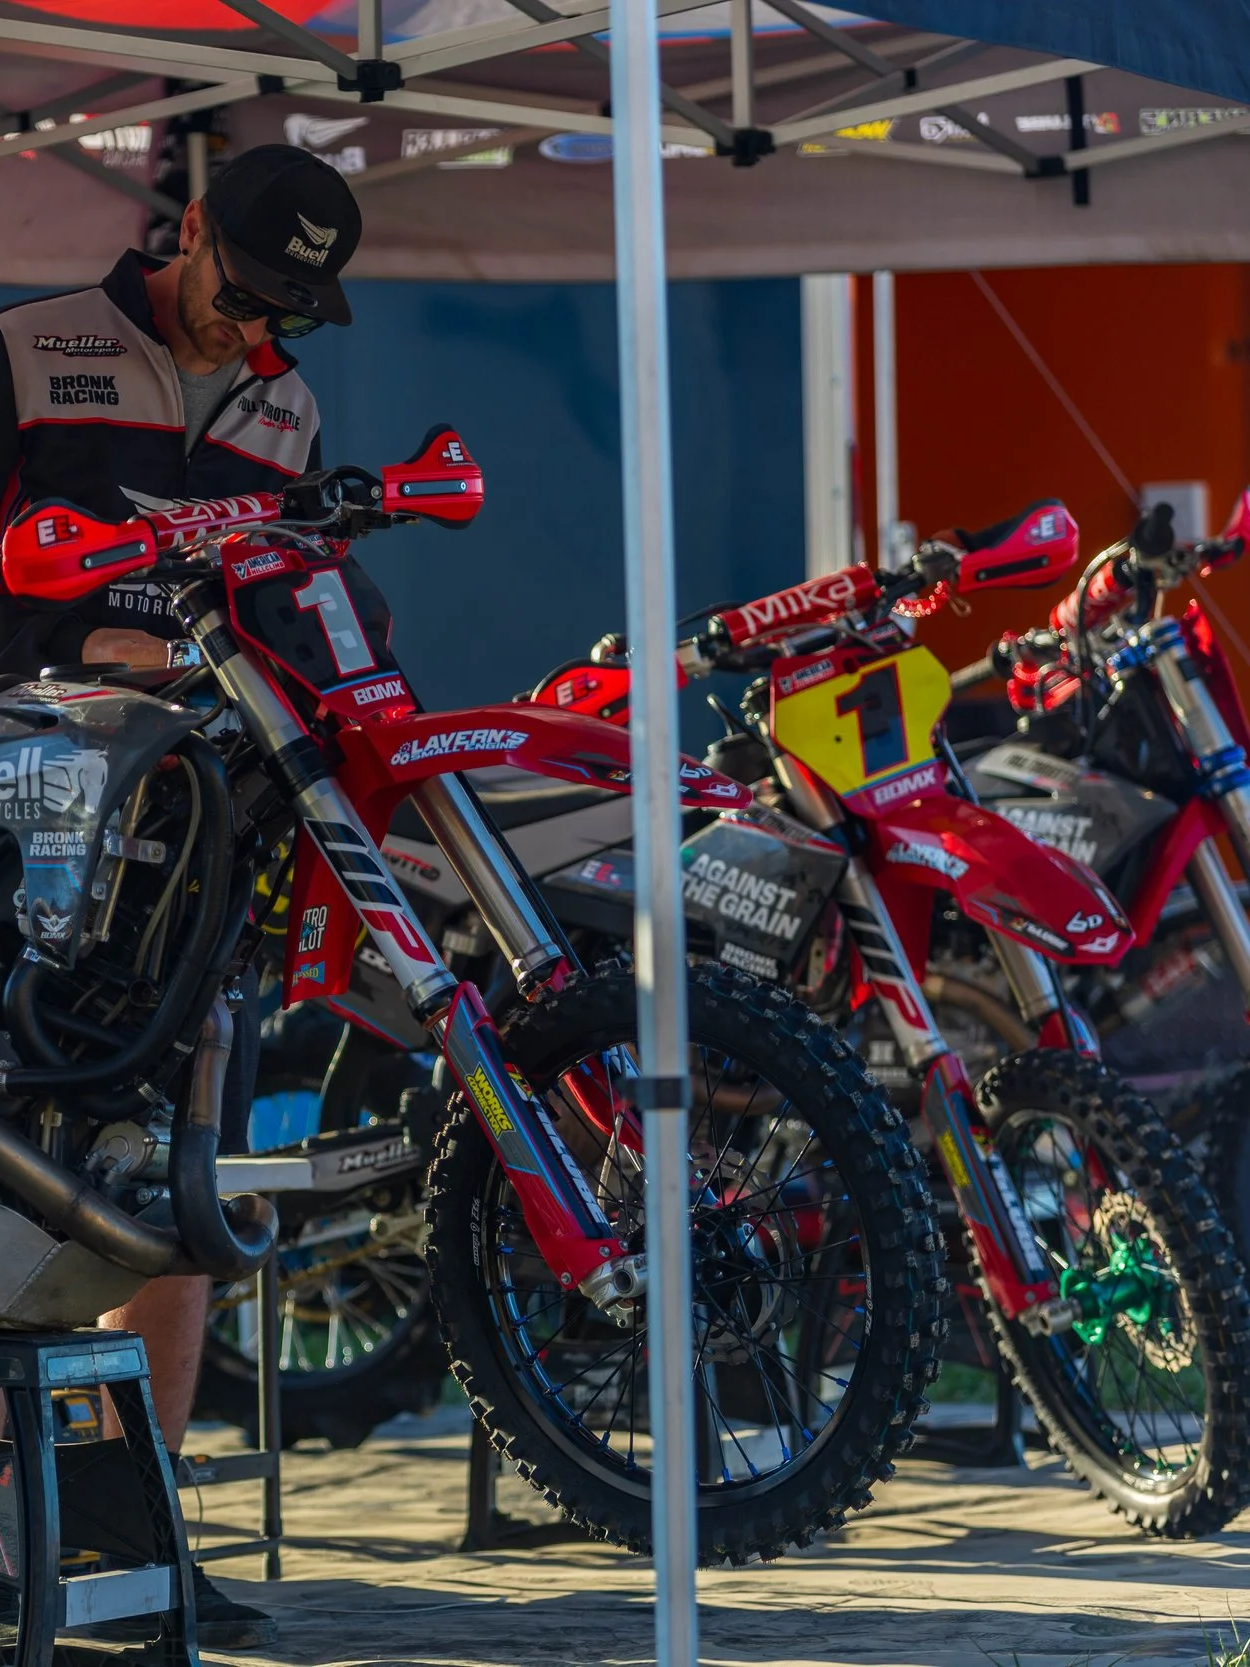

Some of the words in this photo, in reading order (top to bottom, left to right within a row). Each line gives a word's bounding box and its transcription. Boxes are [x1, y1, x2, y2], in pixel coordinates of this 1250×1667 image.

[288, 236, 329, 263] Buell
[37, 336, 117, 349] Mueller
[65, 347, 125, 355] Motorsports
[49, 375, 116, 391] BRONK
[50, 389, 119, 406] RACING
[237, 396, 258, 413] FULL
[260, 400, 301, 431] THROTTLE
[248, 552, 281, 570] AMERICAN
[738, 574, 856, 636] Mika
[294, 568, 376, 675] 1
[353, 680, 406, 706] BDMX
[836, 661, 909, 779] 1
[410, 729, 530, 755] LAVERN'S
[410, 747, 461, 762] SMALL
[30, 844, 86, 857] RACING
[33, 831, 84, 844] BRONK
[689, 853, 797, 911] AGAINST
[718, 893, 802, 940] GRAIN
[466, 1074, 501, 1138] CONNECTION
[473, 1066, 513, 1132] WORKS
